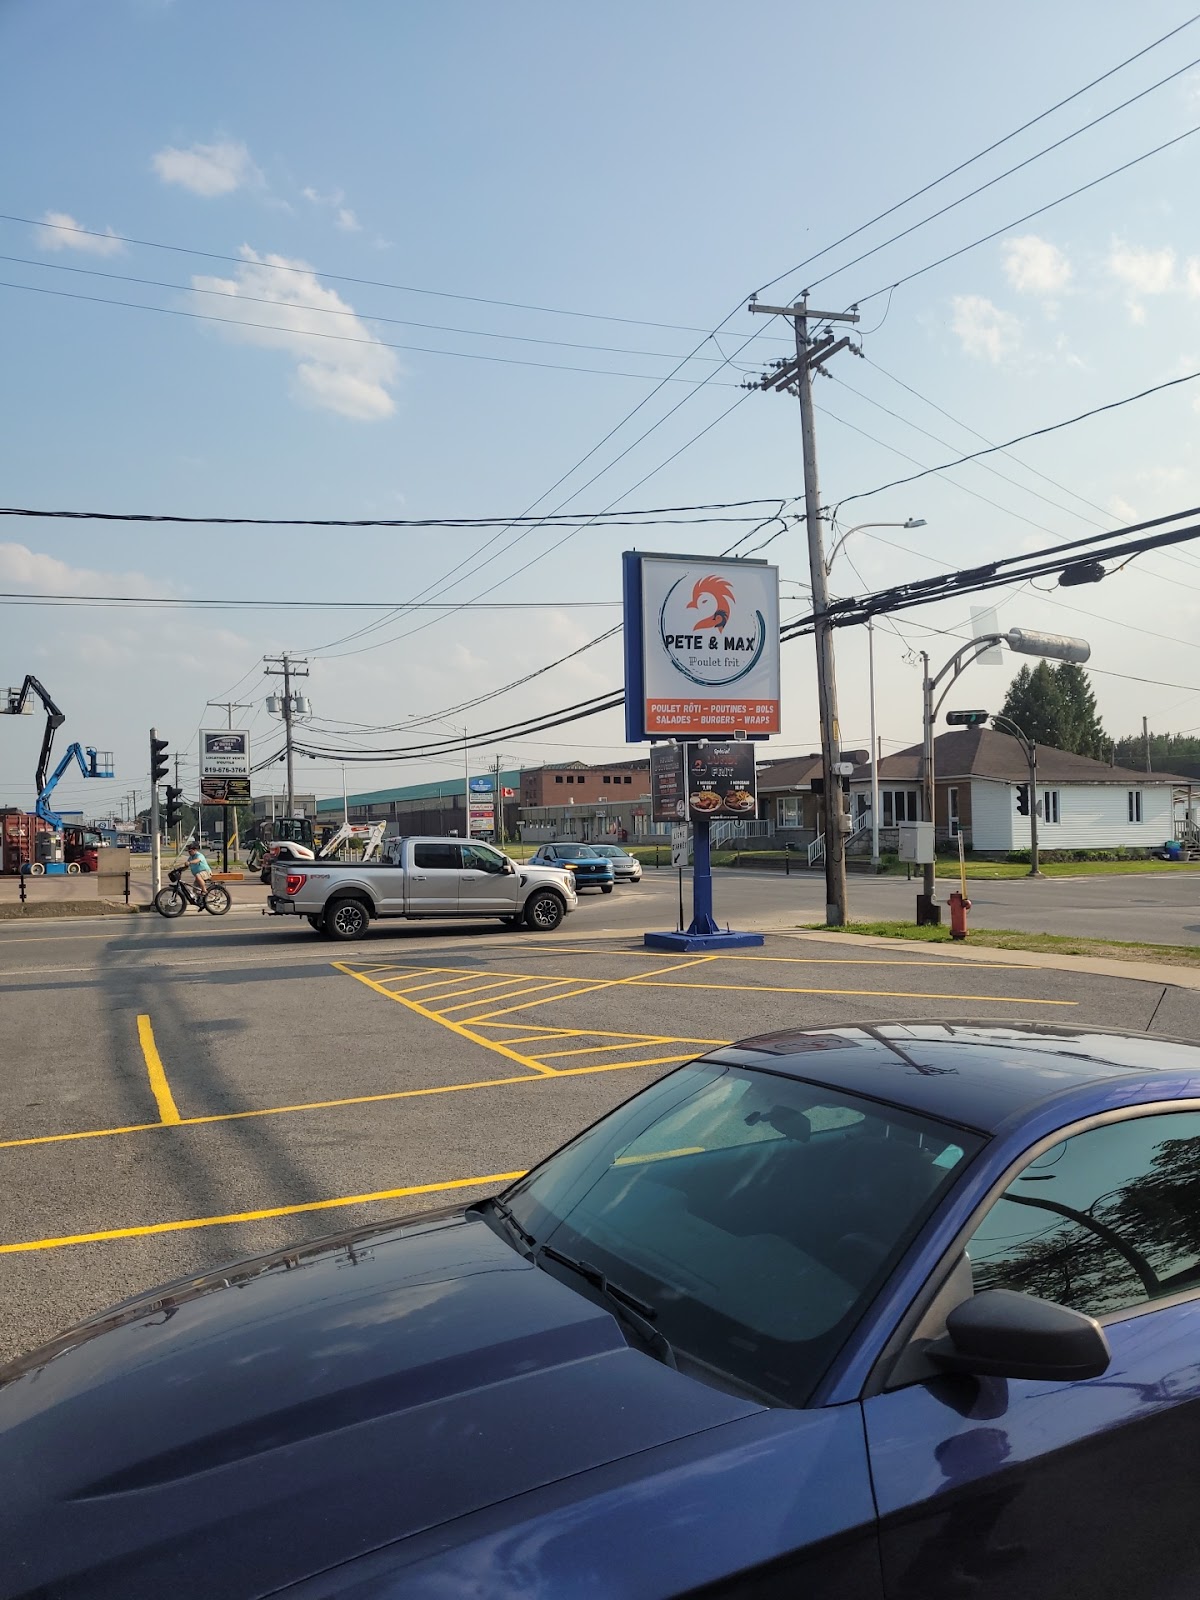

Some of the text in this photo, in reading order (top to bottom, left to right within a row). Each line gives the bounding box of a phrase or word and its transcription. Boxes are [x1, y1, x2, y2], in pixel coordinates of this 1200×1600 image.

[665, 634, 755, 651] PETE & MAX
[689, 656, 739, 667] Poulet frit
[651, 704, 680, 713] POULET
[683, 702, 701, 713] RÔTI
[710, 705, 747, 714] POUTINES
[755, 705, 774, 714] BOLS
[656, 715, 691, 724] SALADES
[700, 715, 735, 724] BURGERS
[744, 716, 770, 724] WRAPS
